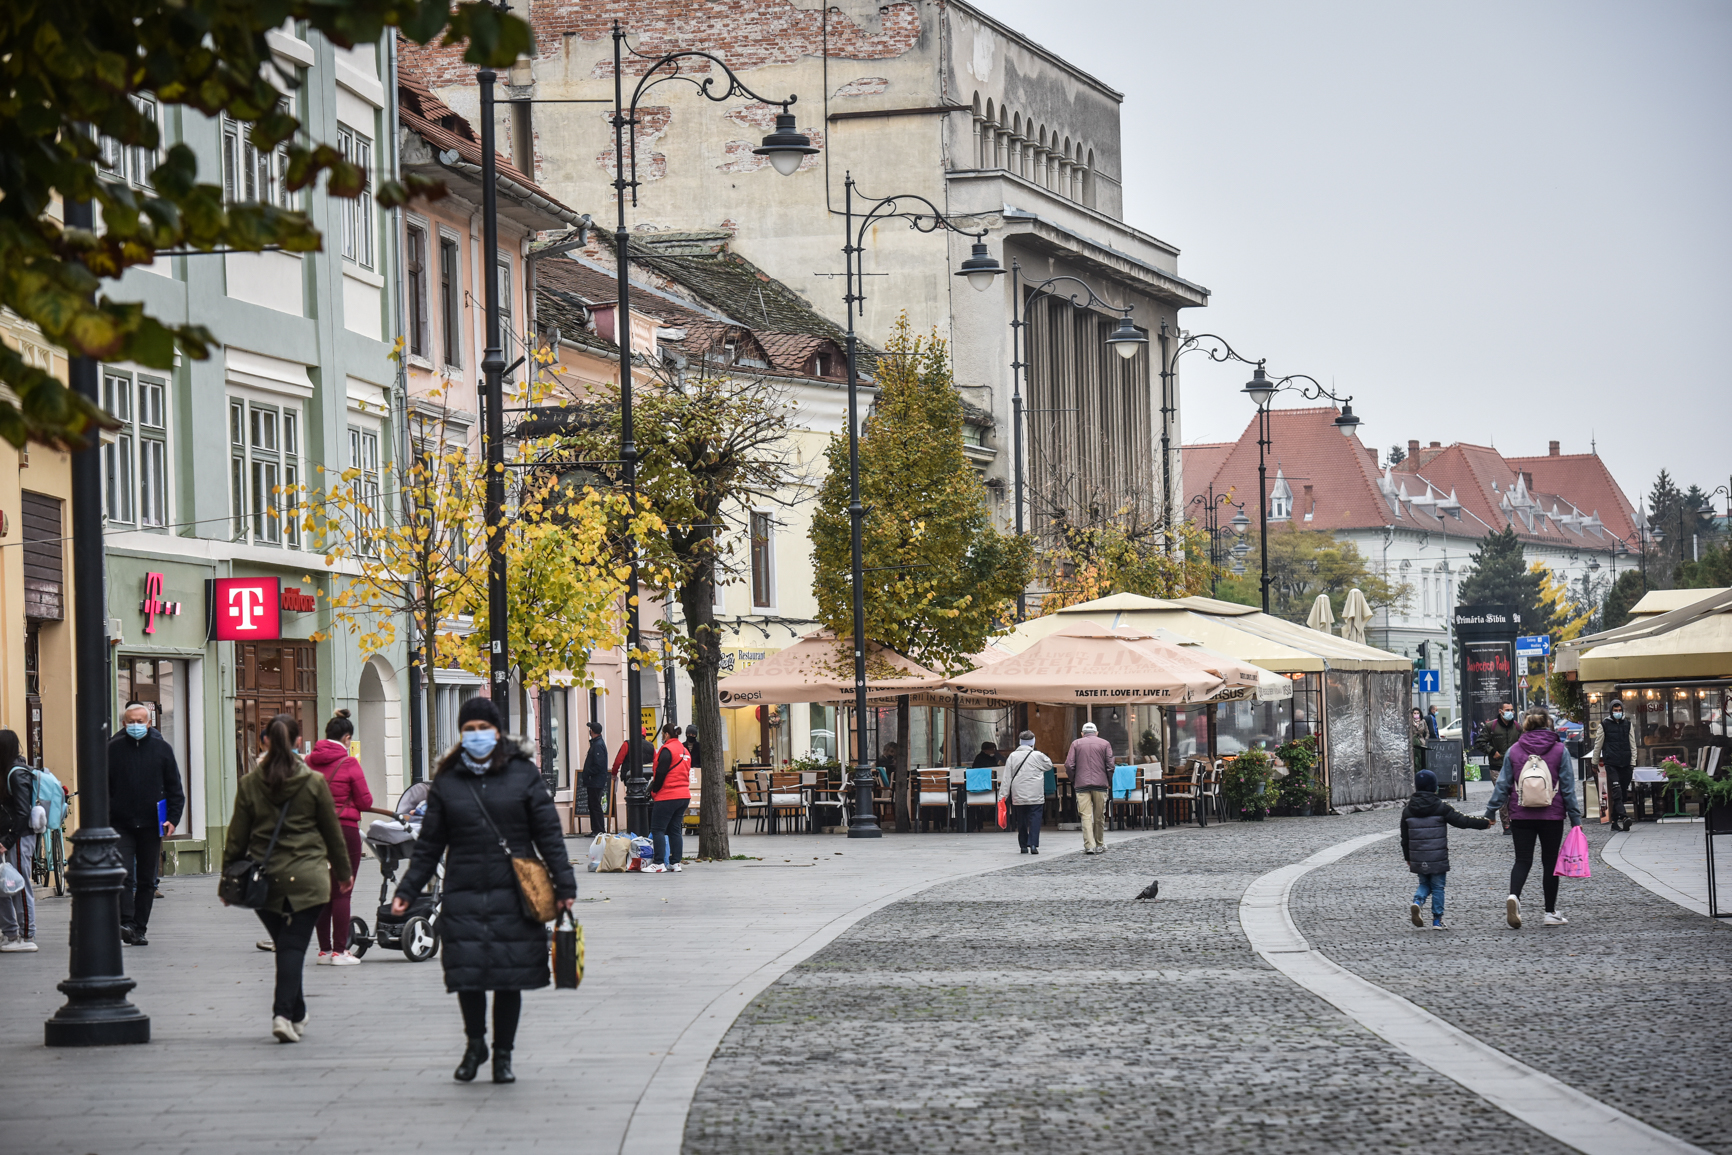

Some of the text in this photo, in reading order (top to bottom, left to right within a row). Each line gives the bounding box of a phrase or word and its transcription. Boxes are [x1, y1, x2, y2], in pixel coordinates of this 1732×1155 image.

[229, 587, 263, 630] T
[1485, 613, 1506, 623] Sibiu
[738, 650, 766, 661] Restaurant
[733, 690, 762, 701] pepsi
[969, 688, 998, 696] pepsi
[1075, 689, 1171, 697] TASTE IT. LOVE IT. LIVE IT.
[909, 693, 924, 702] ERII
[926, 692, 936, 702] ÎN
[986, 698, 1017, 708] URSU
